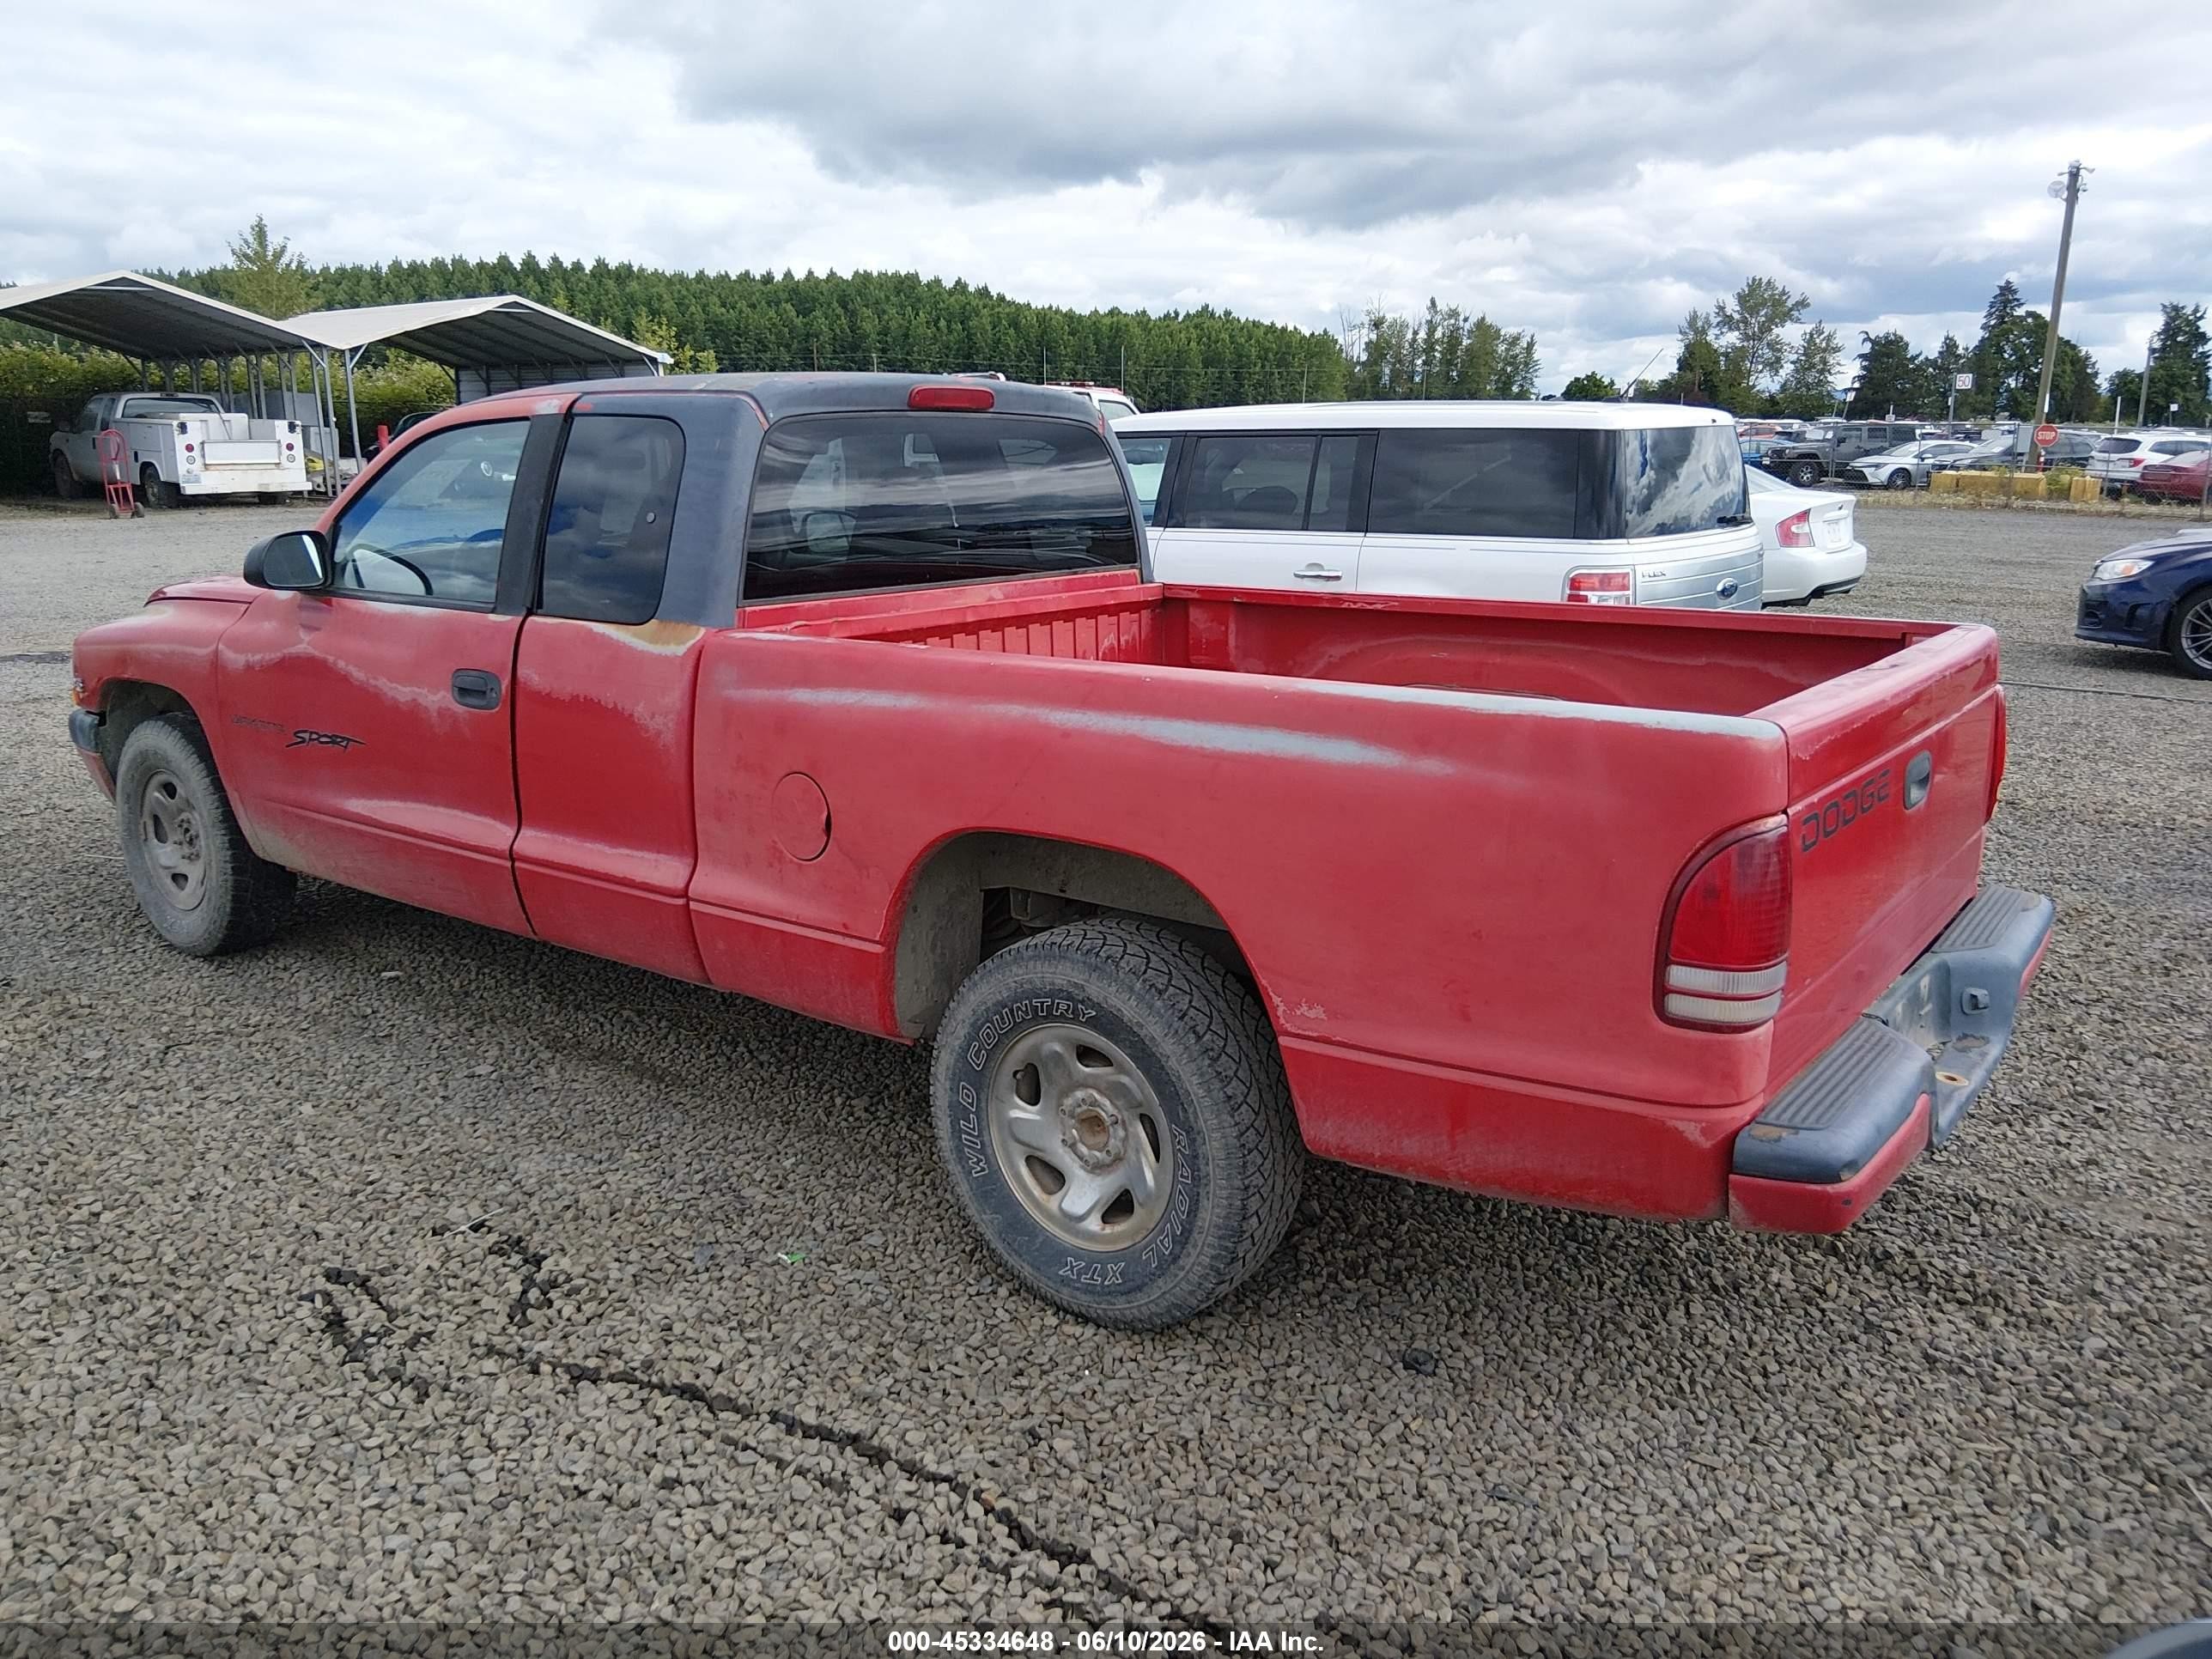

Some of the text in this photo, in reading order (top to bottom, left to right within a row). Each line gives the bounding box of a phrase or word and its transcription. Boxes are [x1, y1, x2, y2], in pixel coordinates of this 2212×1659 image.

[1958, 375, 1971, 387] 50
[2038, 431, 2056, 441] STOP
[285, 729, 367, 752] SPORT
[1801, 769, 1891, 853] DODGE
[959, 998, 1097, 1178] WILD COUNTRY
[1060, 1125, 1193, 1285] RADIAL XTX
